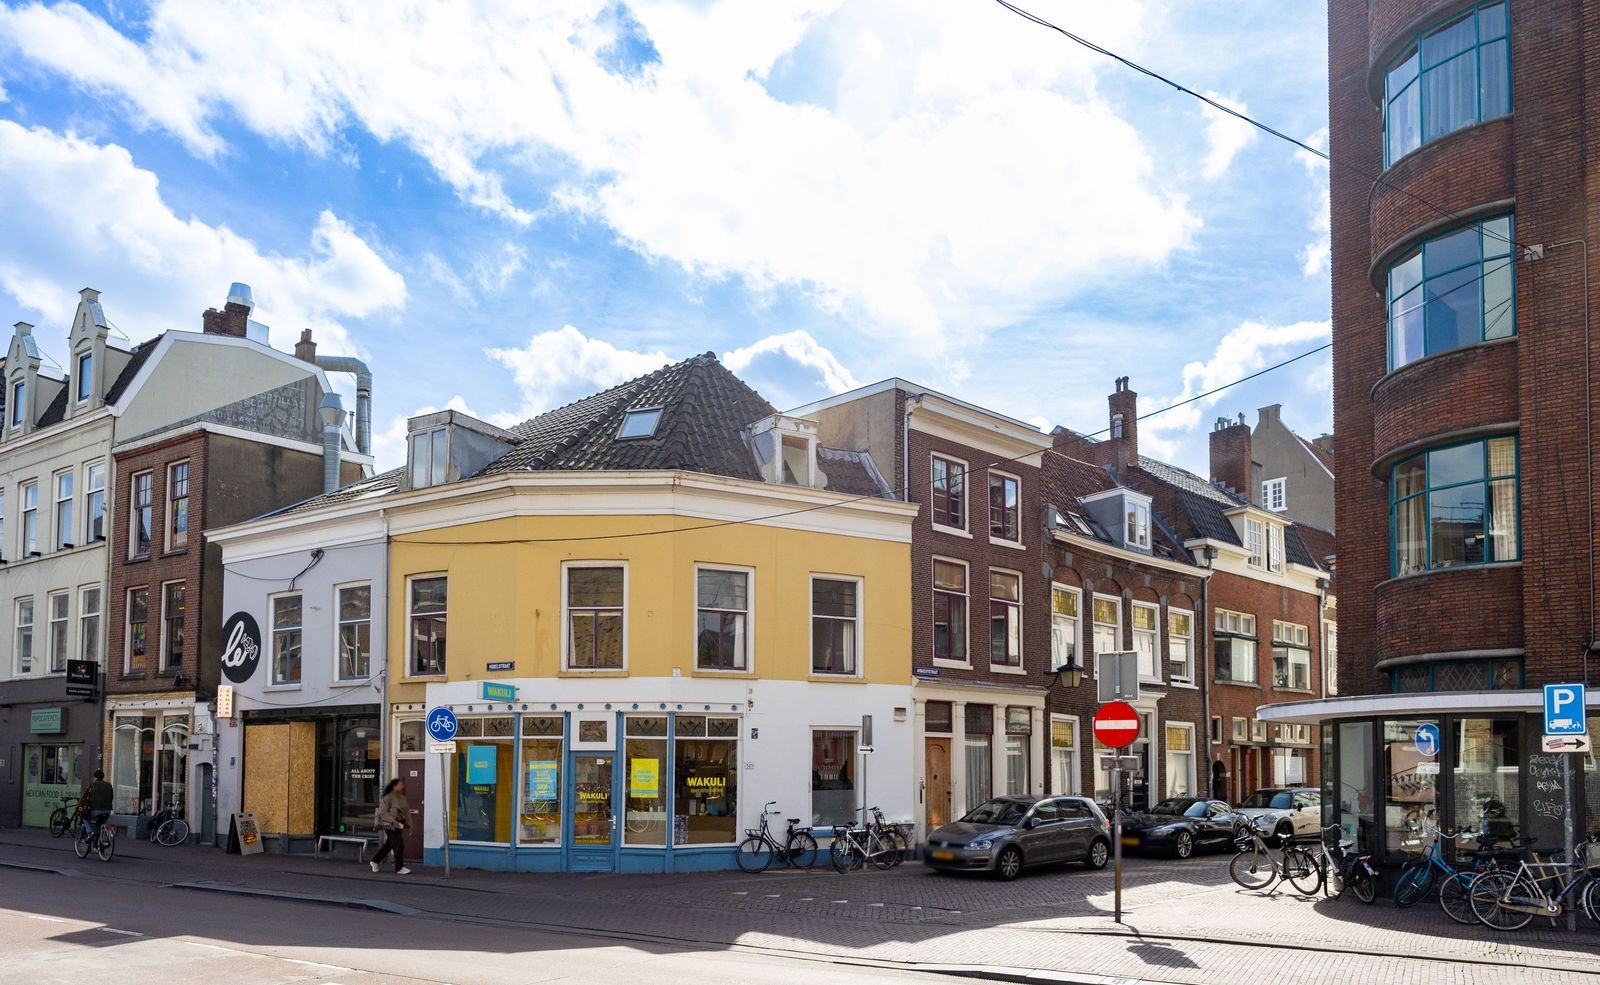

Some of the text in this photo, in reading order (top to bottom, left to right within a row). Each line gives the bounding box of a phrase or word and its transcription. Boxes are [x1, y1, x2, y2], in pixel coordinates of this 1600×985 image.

[487, 686, 512, 698] WAKULI
[1553, 689, 1575, 714] P
[687, 777, 726, 787] WAKULI
[46, 790, 60, 799] FOOD
[579, 791, 607, 800] WAKULI
